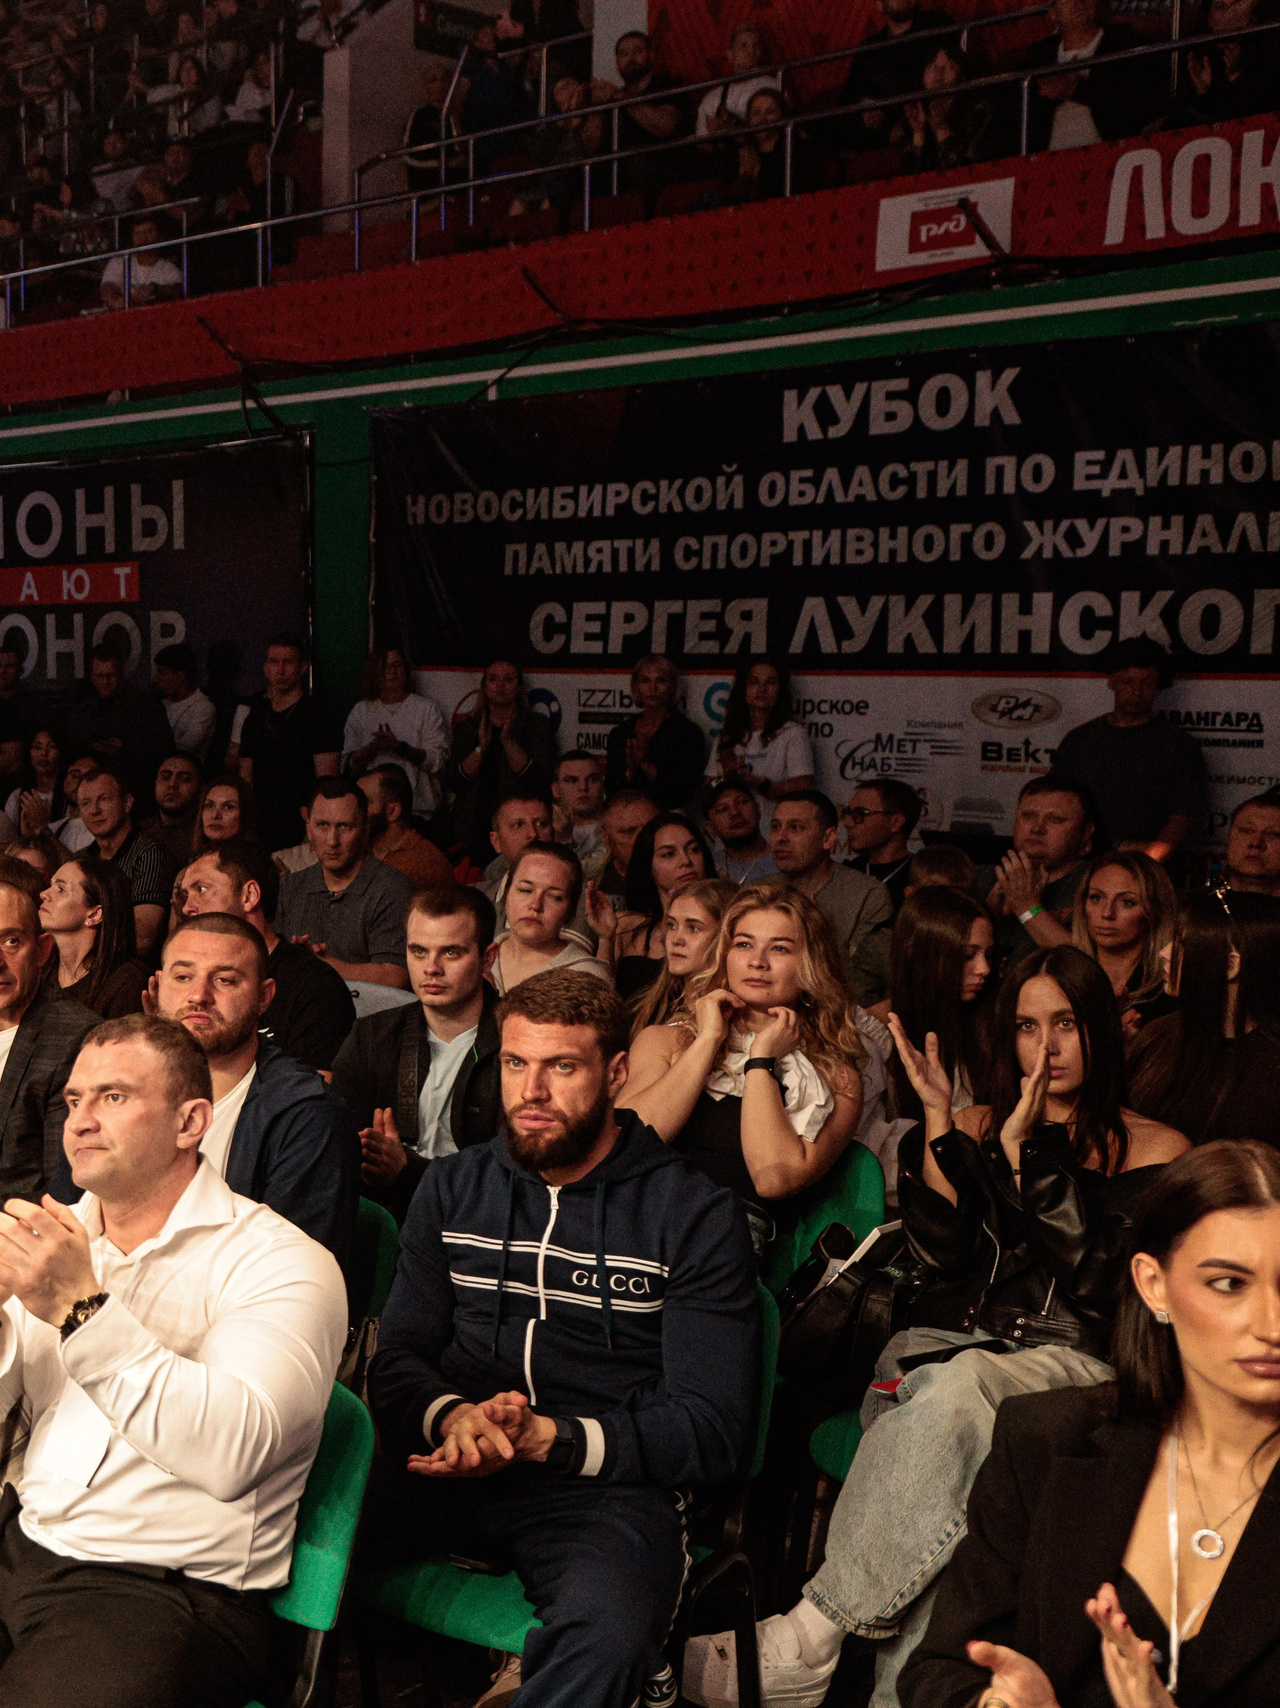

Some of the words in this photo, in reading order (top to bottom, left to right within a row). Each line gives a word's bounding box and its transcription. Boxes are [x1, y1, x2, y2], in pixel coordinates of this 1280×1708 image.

[1102, 128, 1280, 246] ЛОК
[782, 366, 1022, 443] КУБОК
[405, 463, 744, 525] НОВОСИБИРСКОЙ
[757, 458, 969, 508] ОБЛАСТИ
[984, 453, 1056, 496] ПО
[1073, 438, 1280, 497] ЕДИНО
[504, 537, 661, 576] ПАМЯТИ
[674, 521, 1007, 572] СПОРТИВНОГО
[1020, 510, 1280, 560] ЖУРНАЛ
[529, 597, 769, 656] СЕРГЕЯ
[792, 699, 869, 718] ирское
